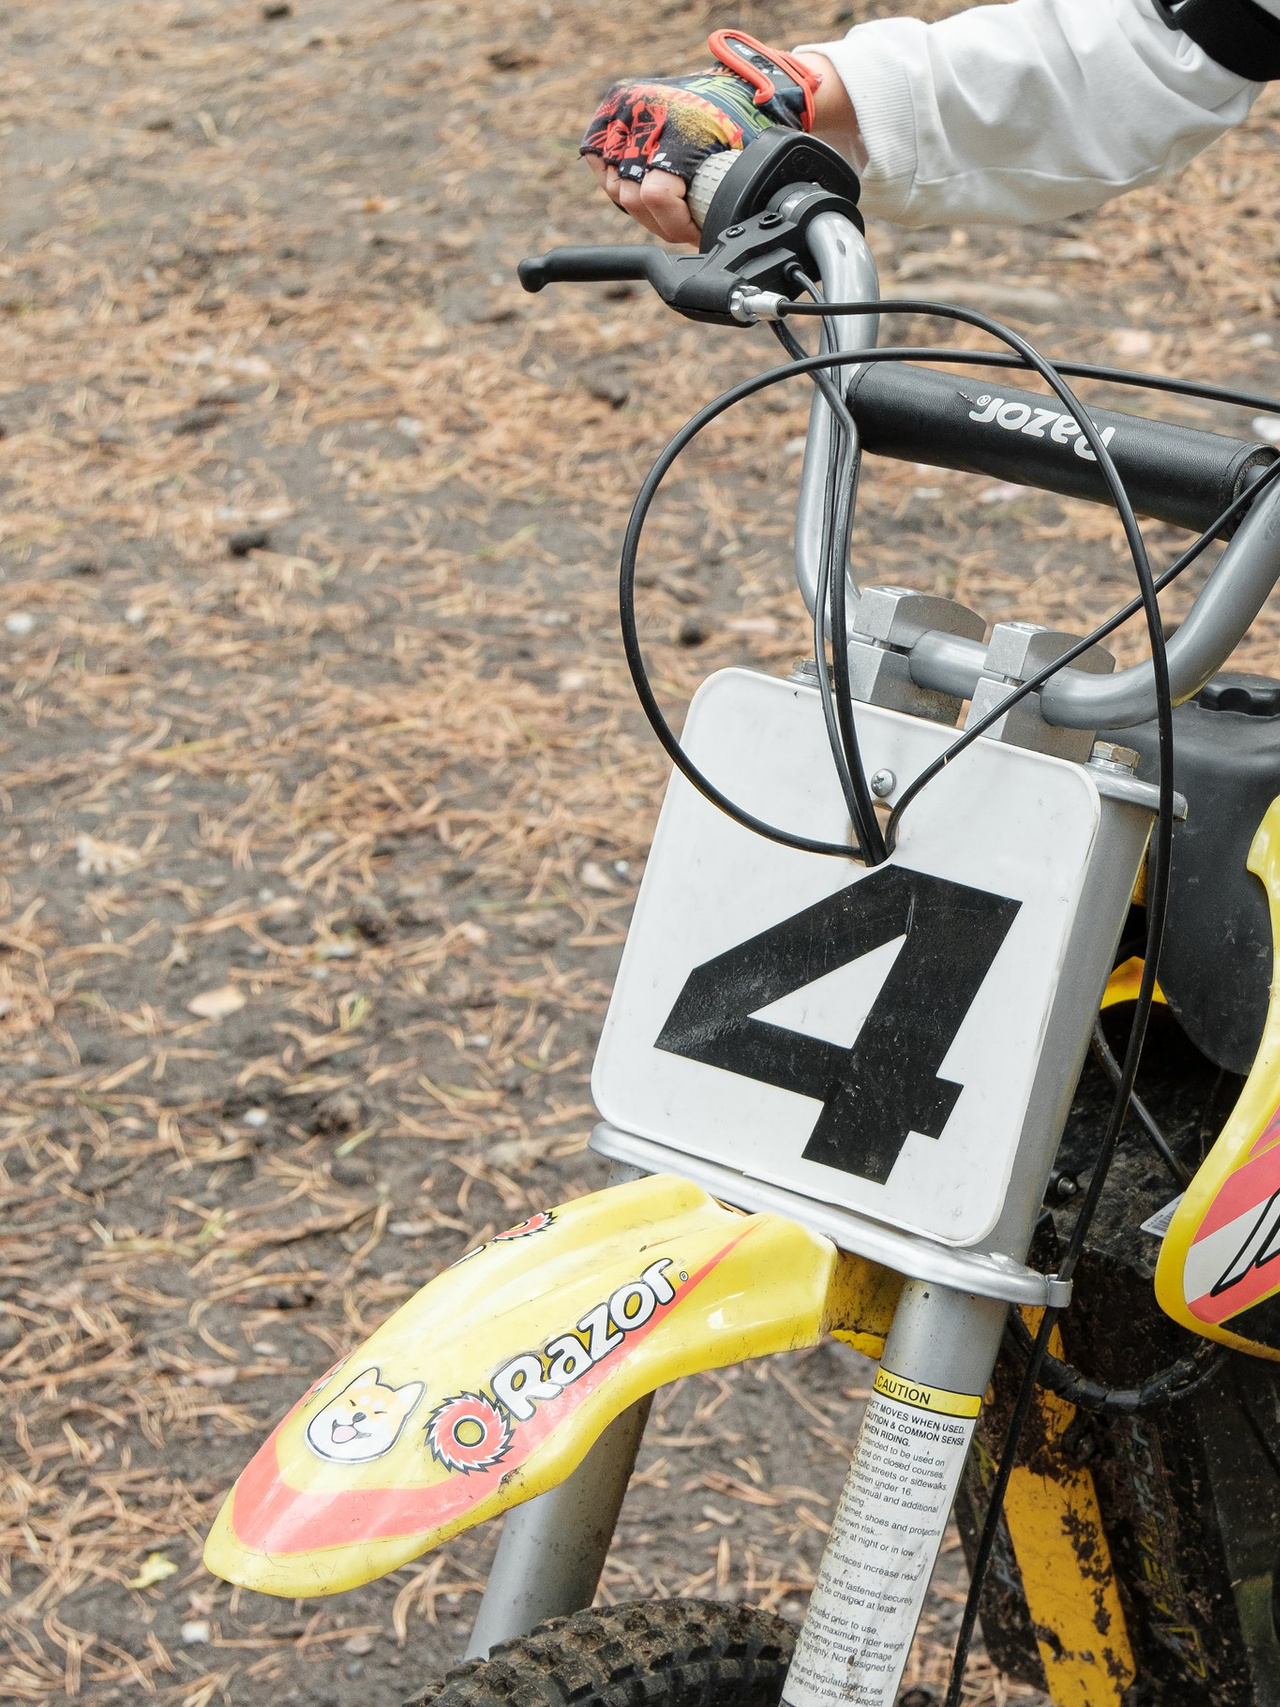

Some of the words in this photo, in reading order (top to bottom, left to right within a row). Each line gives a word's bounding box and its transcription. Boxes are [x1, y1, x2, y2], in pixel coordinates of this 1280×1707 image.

[653, 863, 1023, 1186] 4
[489, 1256, 677, 1422] Razor
[876, 1375, 930, 1404] CAUTION
[879, 1404, 909, 1421] MOVES
[911, 1414, 940, 1431] WHEN
[941, 1423, 964, 1434] USED.
[879, 1429, 910, 1447] RIDING.
[889, 1420, 895, 1430] &
[897, 1423, 940, 1441] COMMON
[940, 1435, 964, 1446] SENSE
[872, 1453, 881, 1461] on
[882, 1457, 911, 1471] closed
[889, 1446, 898, 1455] to
[899, 1448, 910, 1459] be
[912, 1454, 934, 1464] used
[870, 1465, 897, 1479] streets
[898, 1474, 908, 1482] or
[874, 1479, 898, 1492] under
[882, 1495, 900, 1505] and
[900, 1500, 938, 1513] additional
[864, 1513, 889, 1527] shoes
[890, 1522, 908, 1531] and
[849, 1533, 857, 1541] at
[857, 1536, 878, 1548] night
[879, 1543, 889, 1551] or
[890, 1545, 898, 1554] in
[900, 1547, 914, 1556] low
[863, 1562, 899, 1578] increase
[832, 1577, 843, 1587] are
[845, 1581, 881, 1598] fastened
[832, 1590, 865, 1606] charged
[865, 1601, 875, 1609] at
[876, 1602, 896, 1613] least
[830, 1615, 848, 1626] prior
[850, 1620, 859, 1630] to
[822, 1624, 860, 1642] maximum
[862, 1636, 881, 1647] rider
[830, 1651, 846, 1663] Not
[832, 1641, 858, 1655] cause
[860, 1646, 892, 1662] damage
